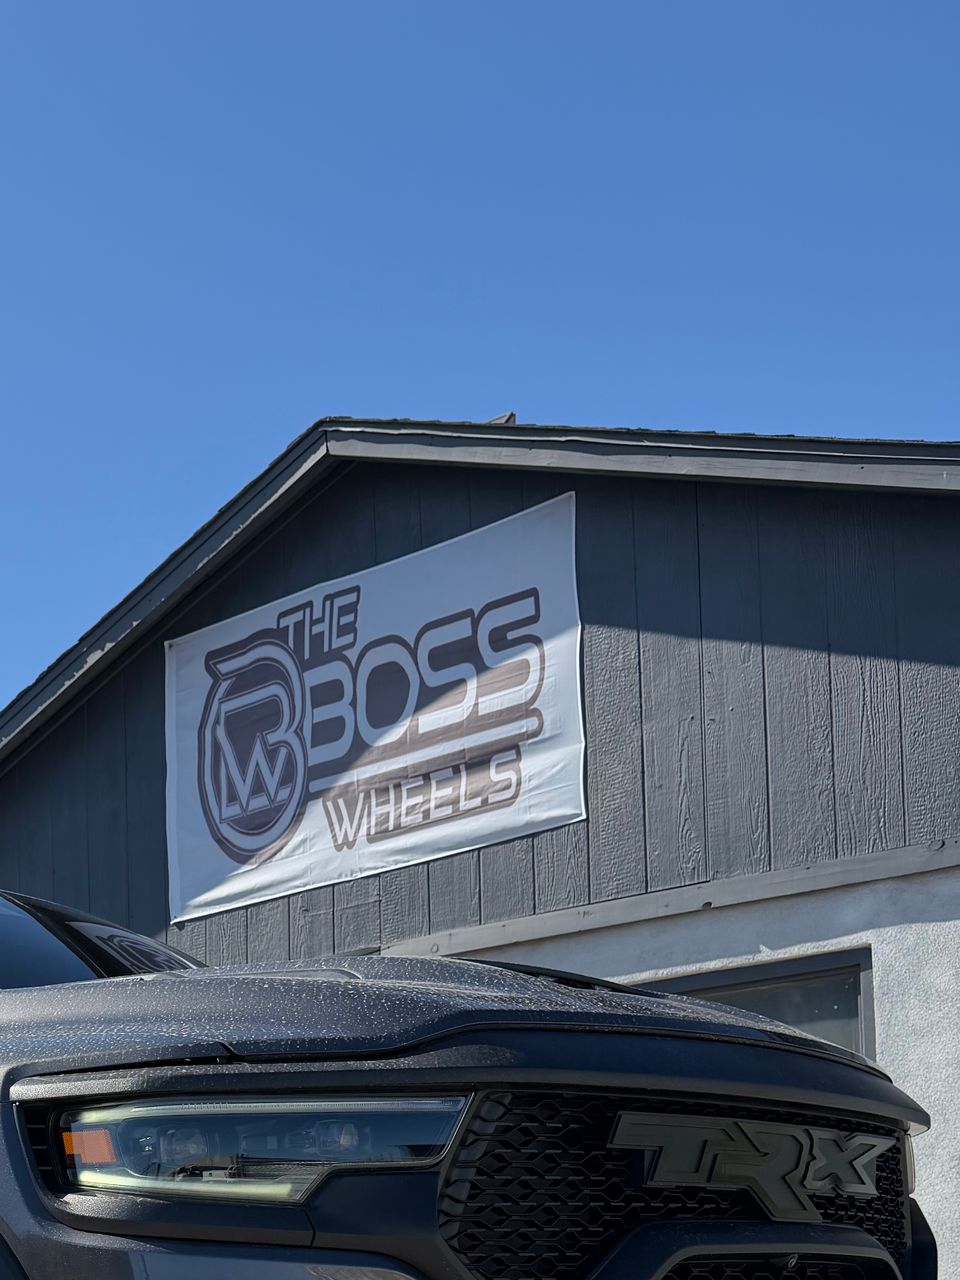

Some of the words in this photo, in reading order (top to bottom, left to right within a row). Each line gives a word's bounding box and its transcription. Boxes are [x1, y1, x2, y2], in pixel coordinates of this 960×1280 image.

[278, 587, 360, 659] THE
[304, 591, 544, 764] BOSS
[324, 746, 520, 849] WHEELS
[606, 1113, 896, 1222] TRX
